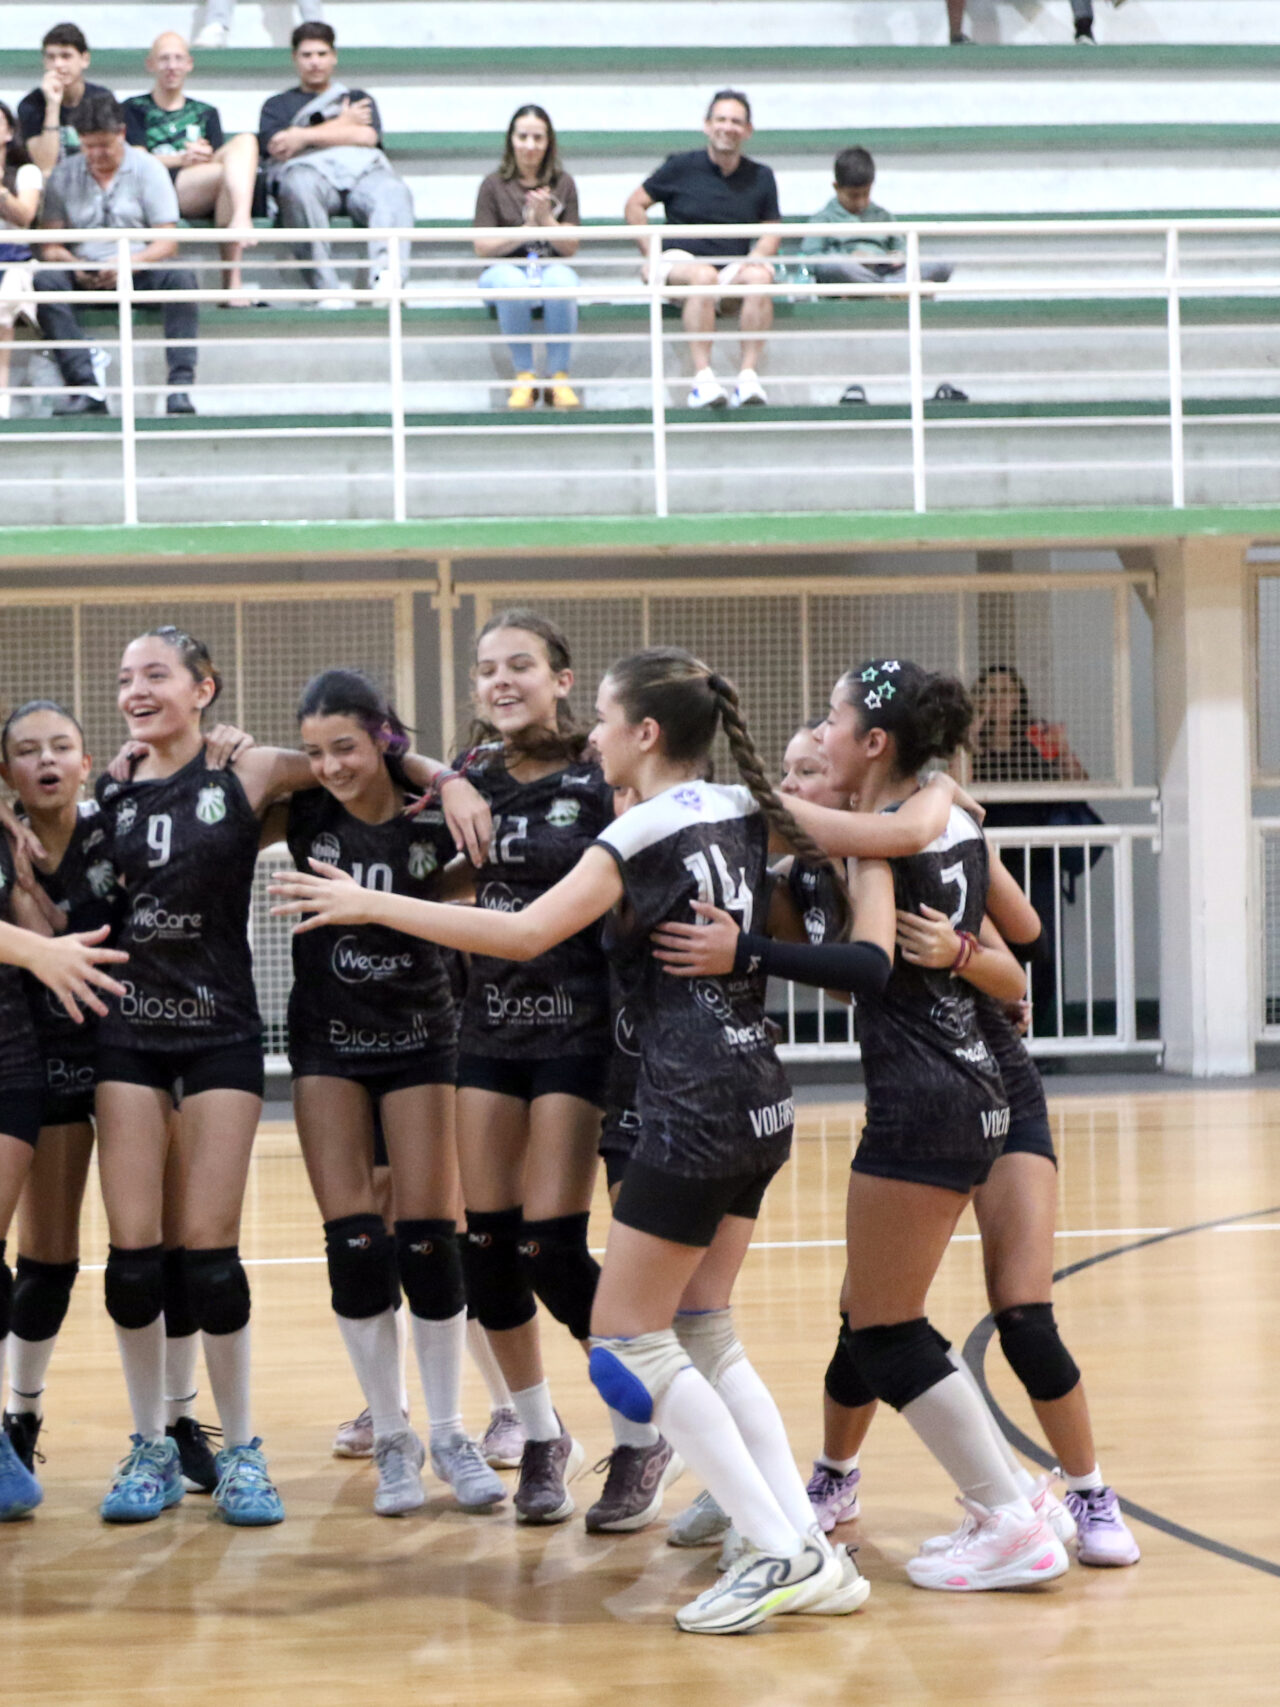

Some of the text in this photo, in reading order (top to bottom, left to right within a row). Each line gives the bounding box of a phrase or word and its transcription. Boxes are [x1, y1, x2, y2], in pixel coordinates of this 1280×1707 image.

[146, 812, 173, 869] 9
[489, 814, 529, 865] 12
[682, 843, 754, 935] 14
[939, 859, 969, 928] 7
[132, 907, 202, 929] WeCare
[120, 980, 217, 1018] Biosalli
